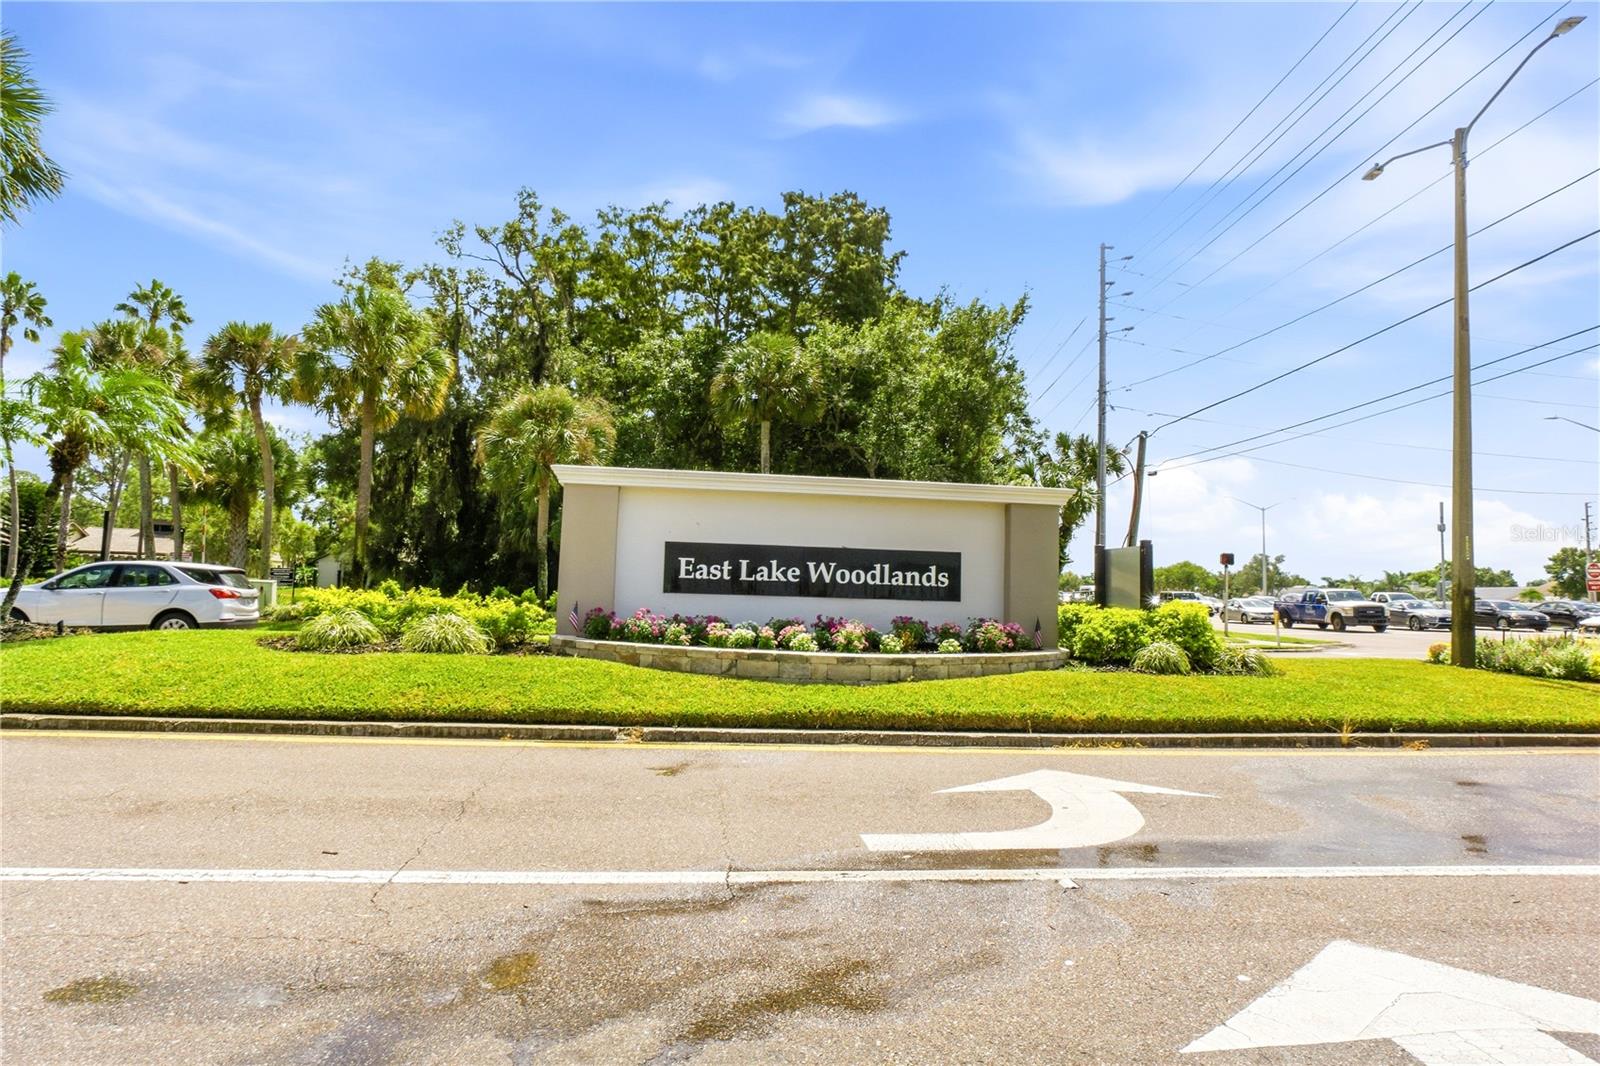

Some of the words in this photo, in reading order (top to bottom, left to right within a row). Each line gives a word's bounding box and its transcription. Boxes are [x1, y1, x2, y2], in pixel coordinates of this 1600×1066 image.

[677, 557, 732, 580] East
[738, 559, 801, 583] Lake
[806, 561, 949, 587] Woodlands
